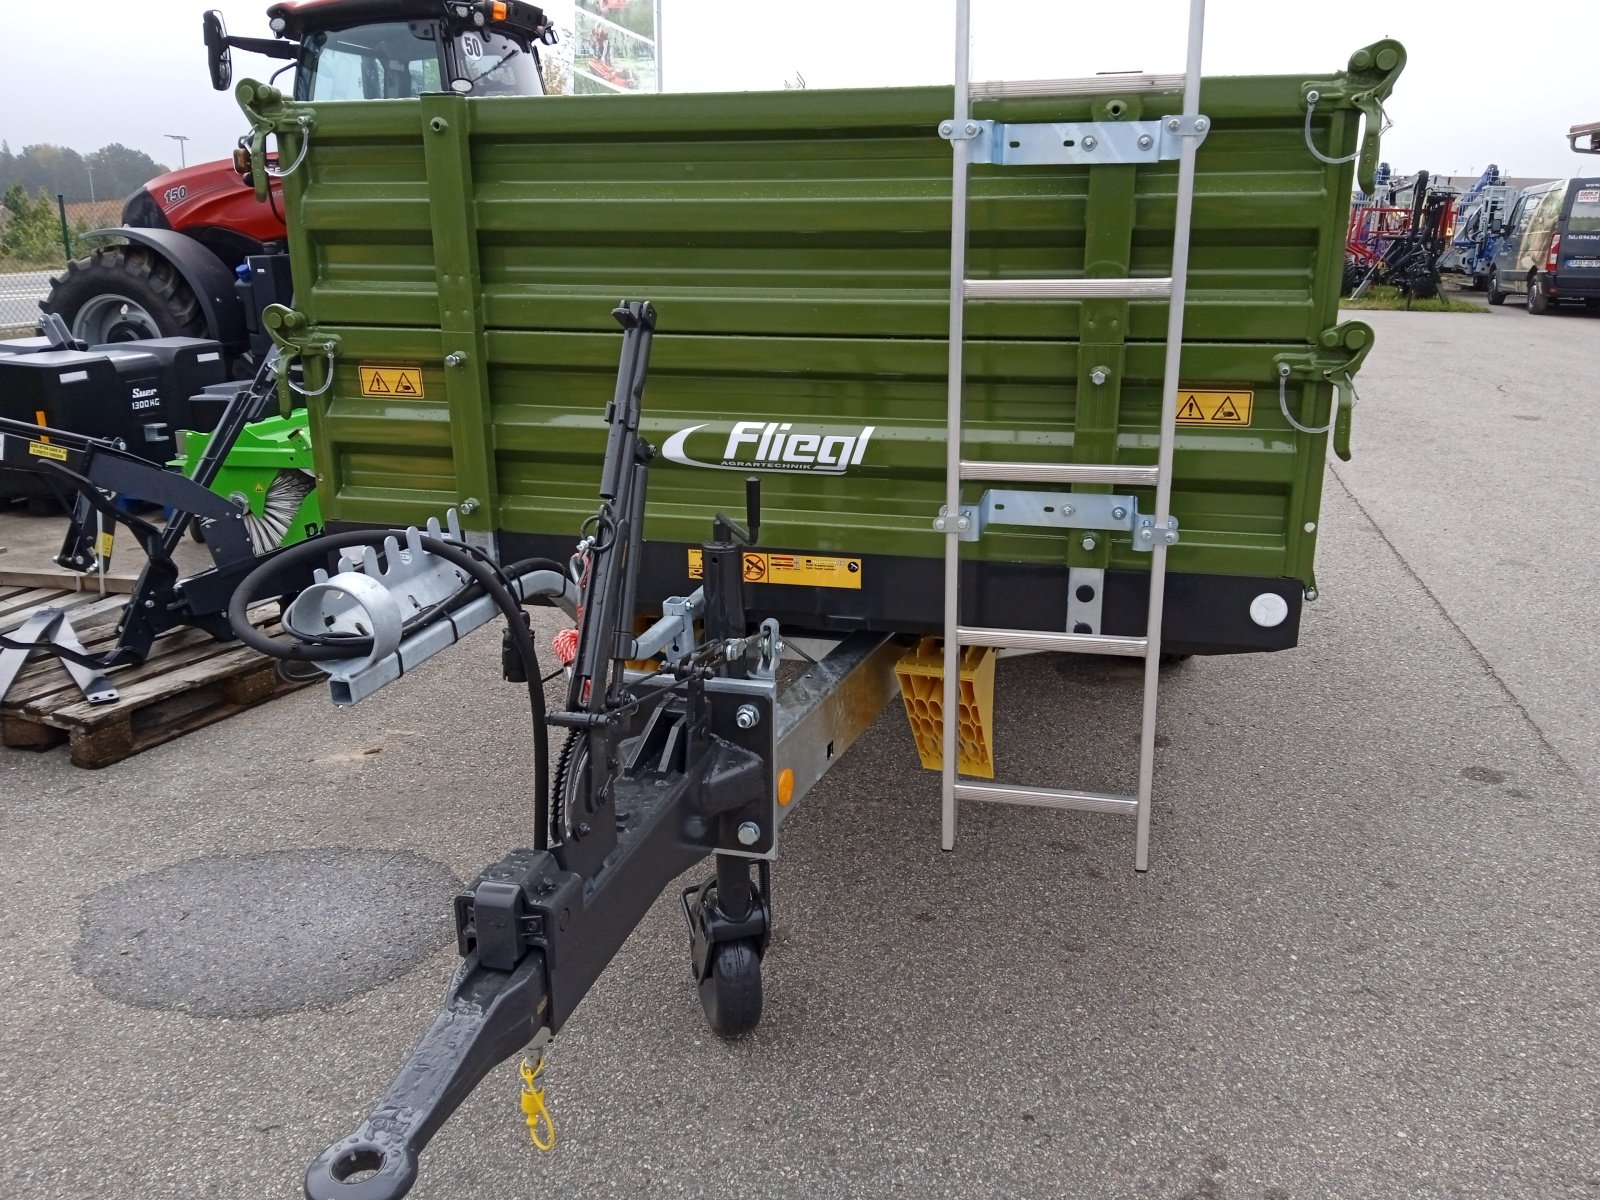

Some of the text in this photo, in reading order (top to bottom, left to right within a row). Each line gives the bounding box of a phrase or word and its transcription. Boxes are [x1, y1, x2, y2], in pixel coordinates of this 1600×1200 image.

[464, 36, 481, 58] 50
[163, 185, 187, 204] 150
[132, 387, 157, 399] Suer
[723, 421, 875, 471] Fliegl
[720, 460, 812, 470] AGRARTECHNIK
